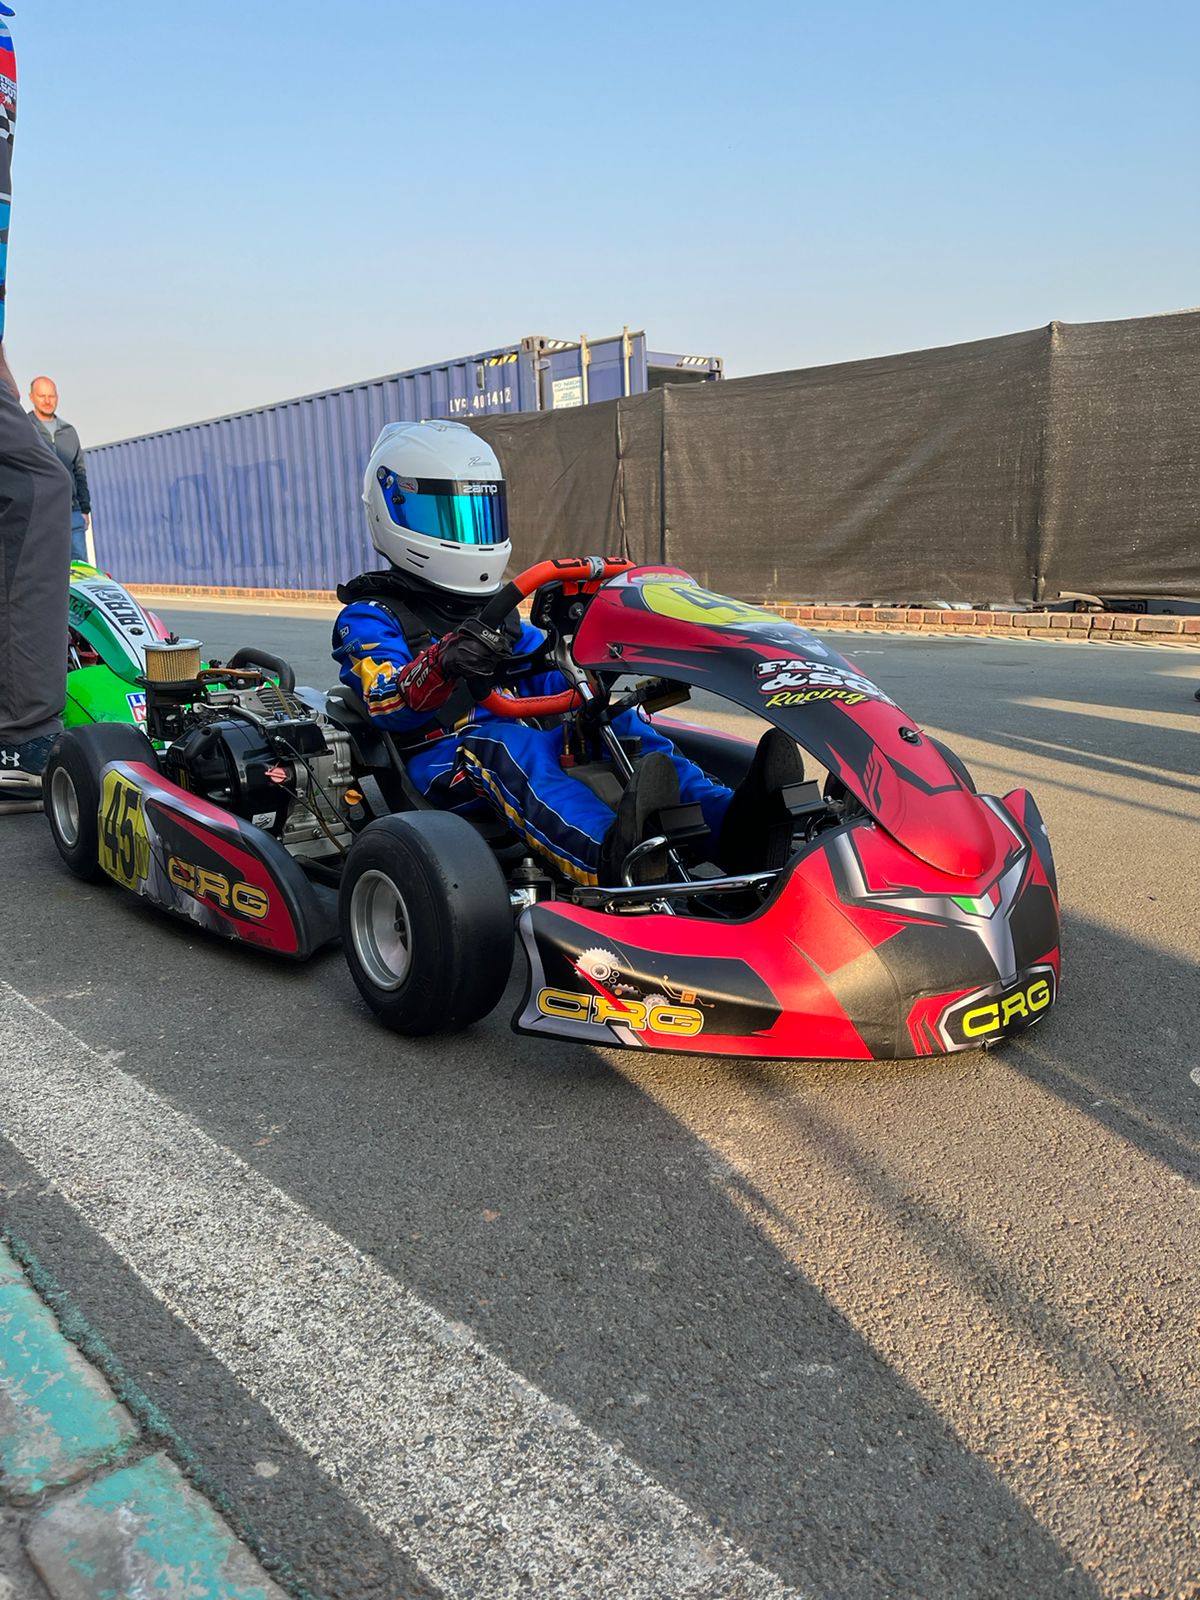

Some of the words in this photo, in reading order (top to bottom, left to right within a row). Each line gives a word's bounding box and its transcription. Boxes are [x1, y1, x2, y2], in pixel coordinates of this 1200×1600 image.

[463, 484, 498, 495] zamp
[760, 672, 808, 691] &
[808, 672, 896, 706] SO
[765, 688, 869, 708] Racing
[104, 780, 141, 880] 45
[167, 854, 269, 920] CRG
[536, 987, 704, 1037] CRG
[962, 979, 1050, 1038] CRG
